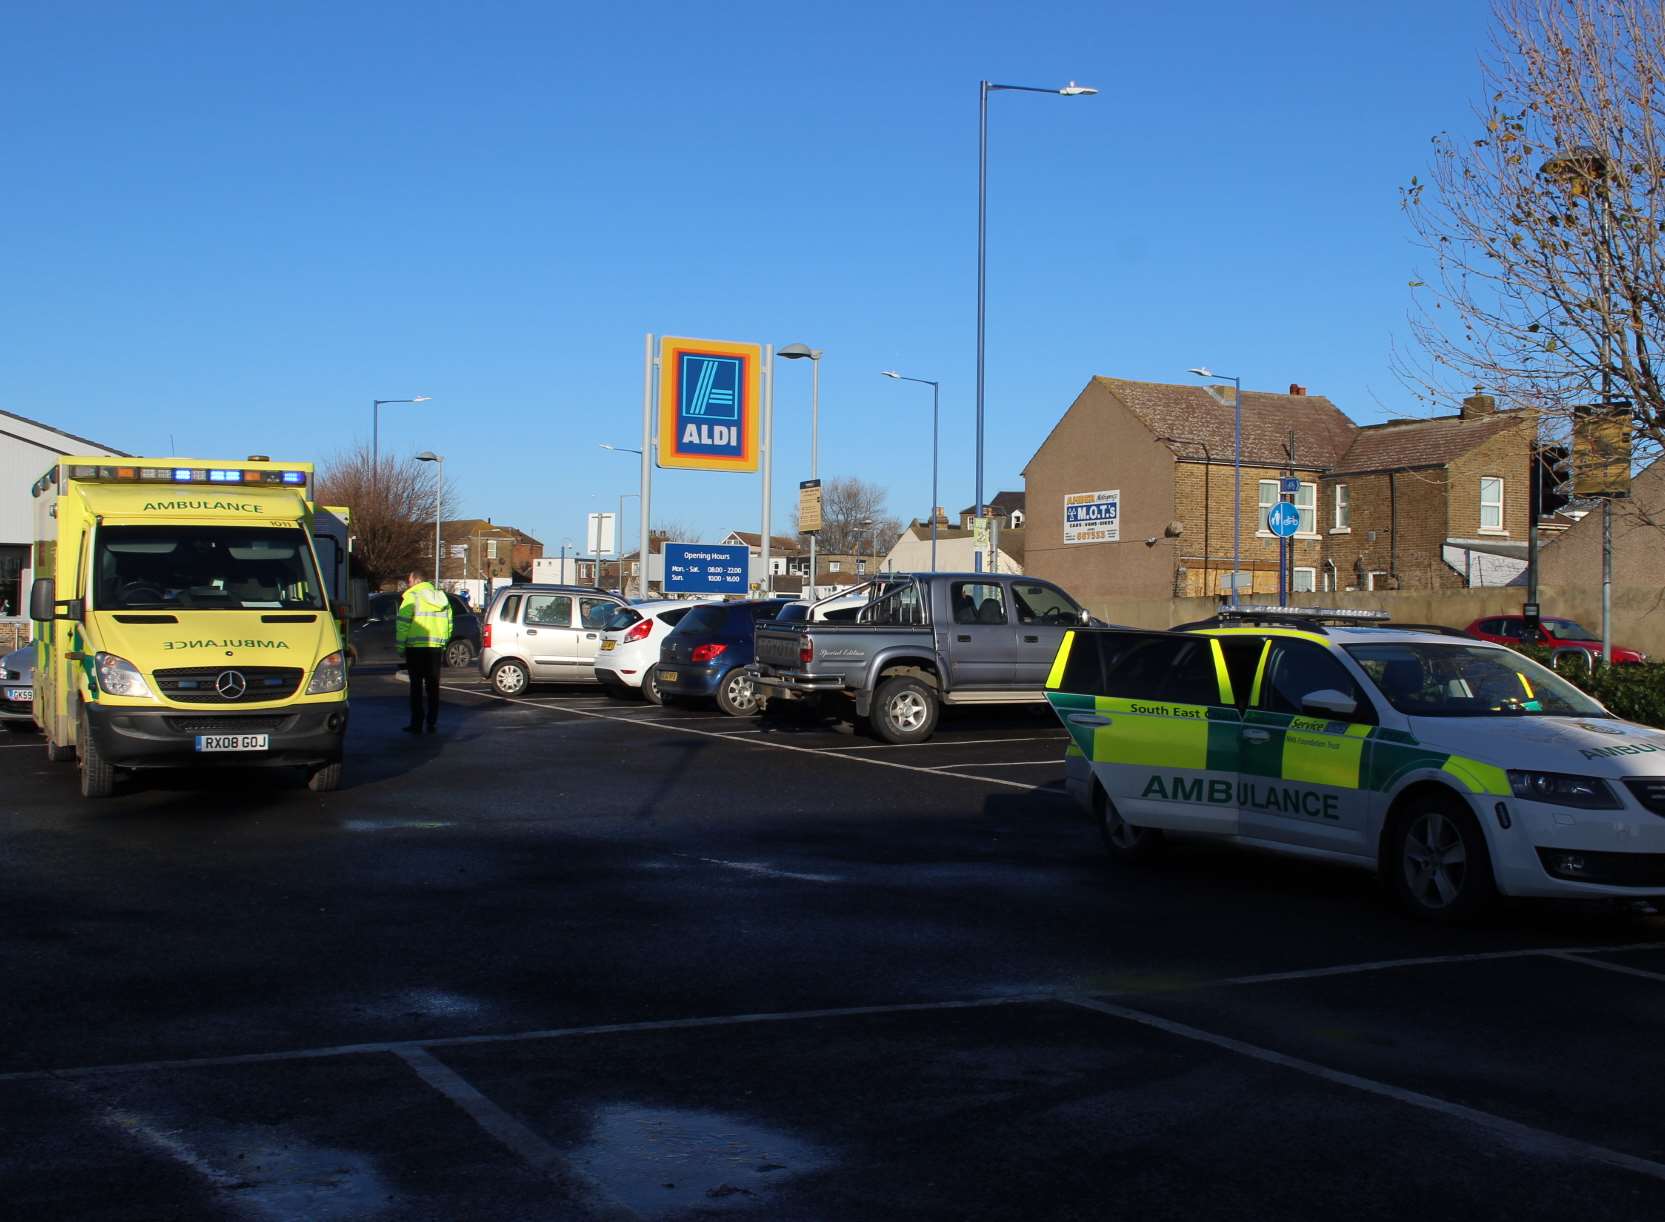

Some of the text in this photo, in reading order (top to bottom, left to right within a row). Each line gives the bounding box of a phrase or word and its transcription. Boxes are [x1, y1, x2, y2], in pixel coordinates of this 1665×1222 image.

[682, 423, 737, 446] ALDI
[143, 501, 264, 513] AMBULANCE
[684, 551, 711, 561] Opening
[1130, 703, 1169, 716] South
[1173, 707, 1201, 719] East
[1291, 718, 1325, 731] Service
[205, 736, 266, 749] RX08 GOJ
[1141, 774, 1340, 821] AMBULANCE
